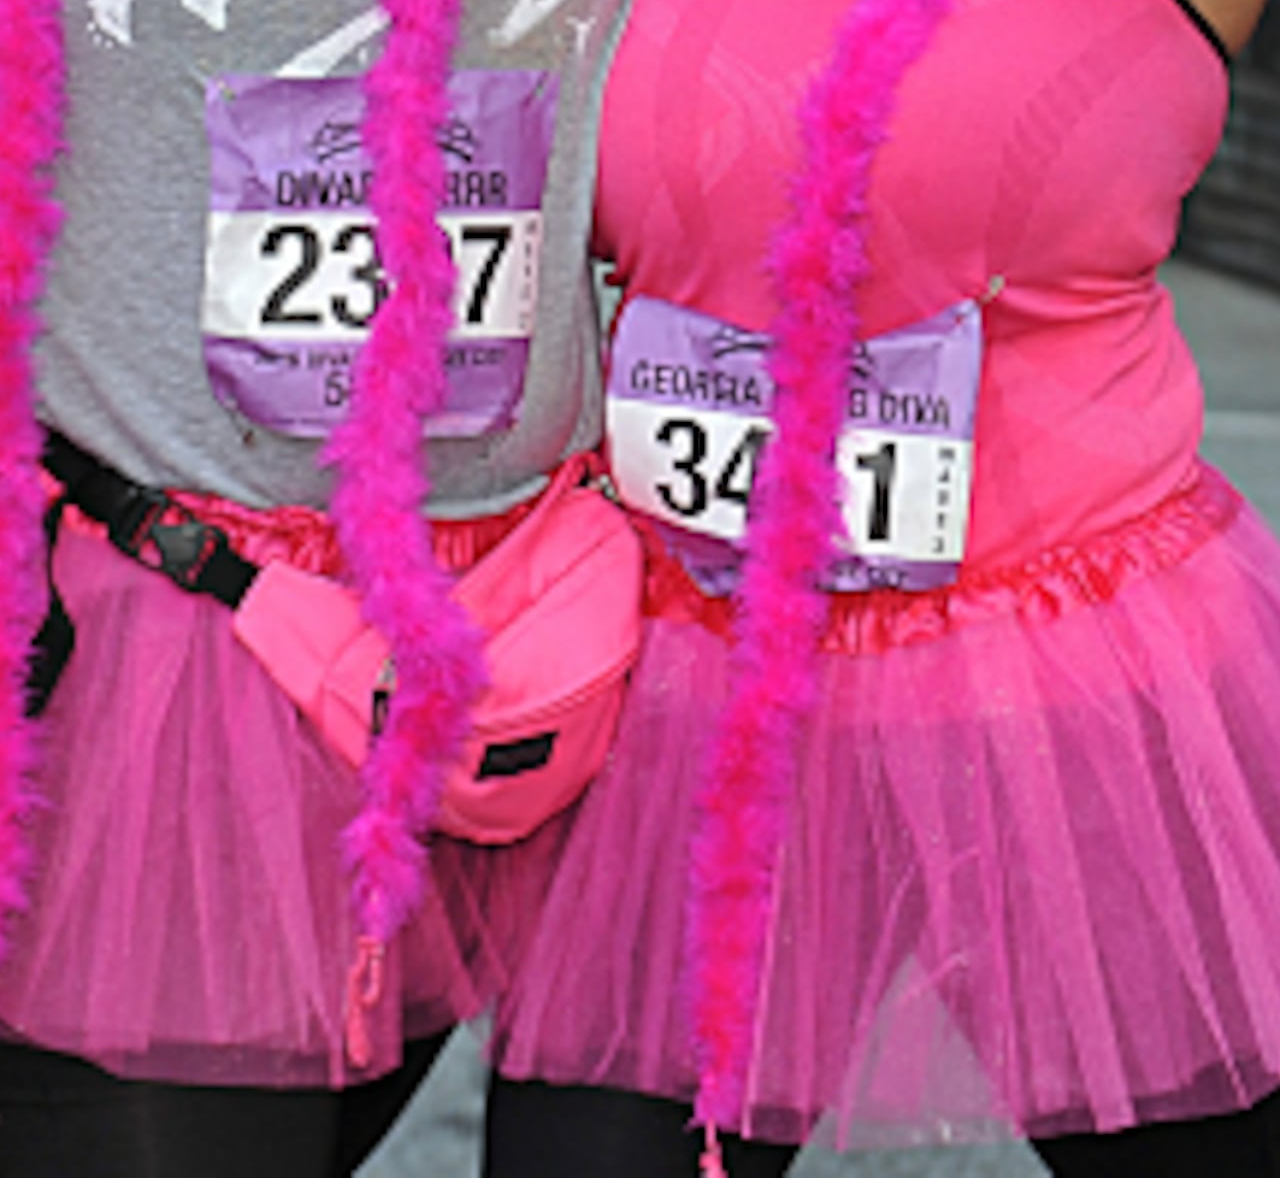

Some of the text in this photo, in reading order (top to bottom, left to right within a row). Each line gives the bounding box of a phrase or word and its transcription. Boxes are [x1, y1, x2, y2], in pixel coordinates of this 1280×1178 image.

[260, 223, 513, 328] 237
[630, 359, 763, 408] GEORGIA
[879, 389, 951, 430] DIVA
[654, 418, 898, 542] 341
